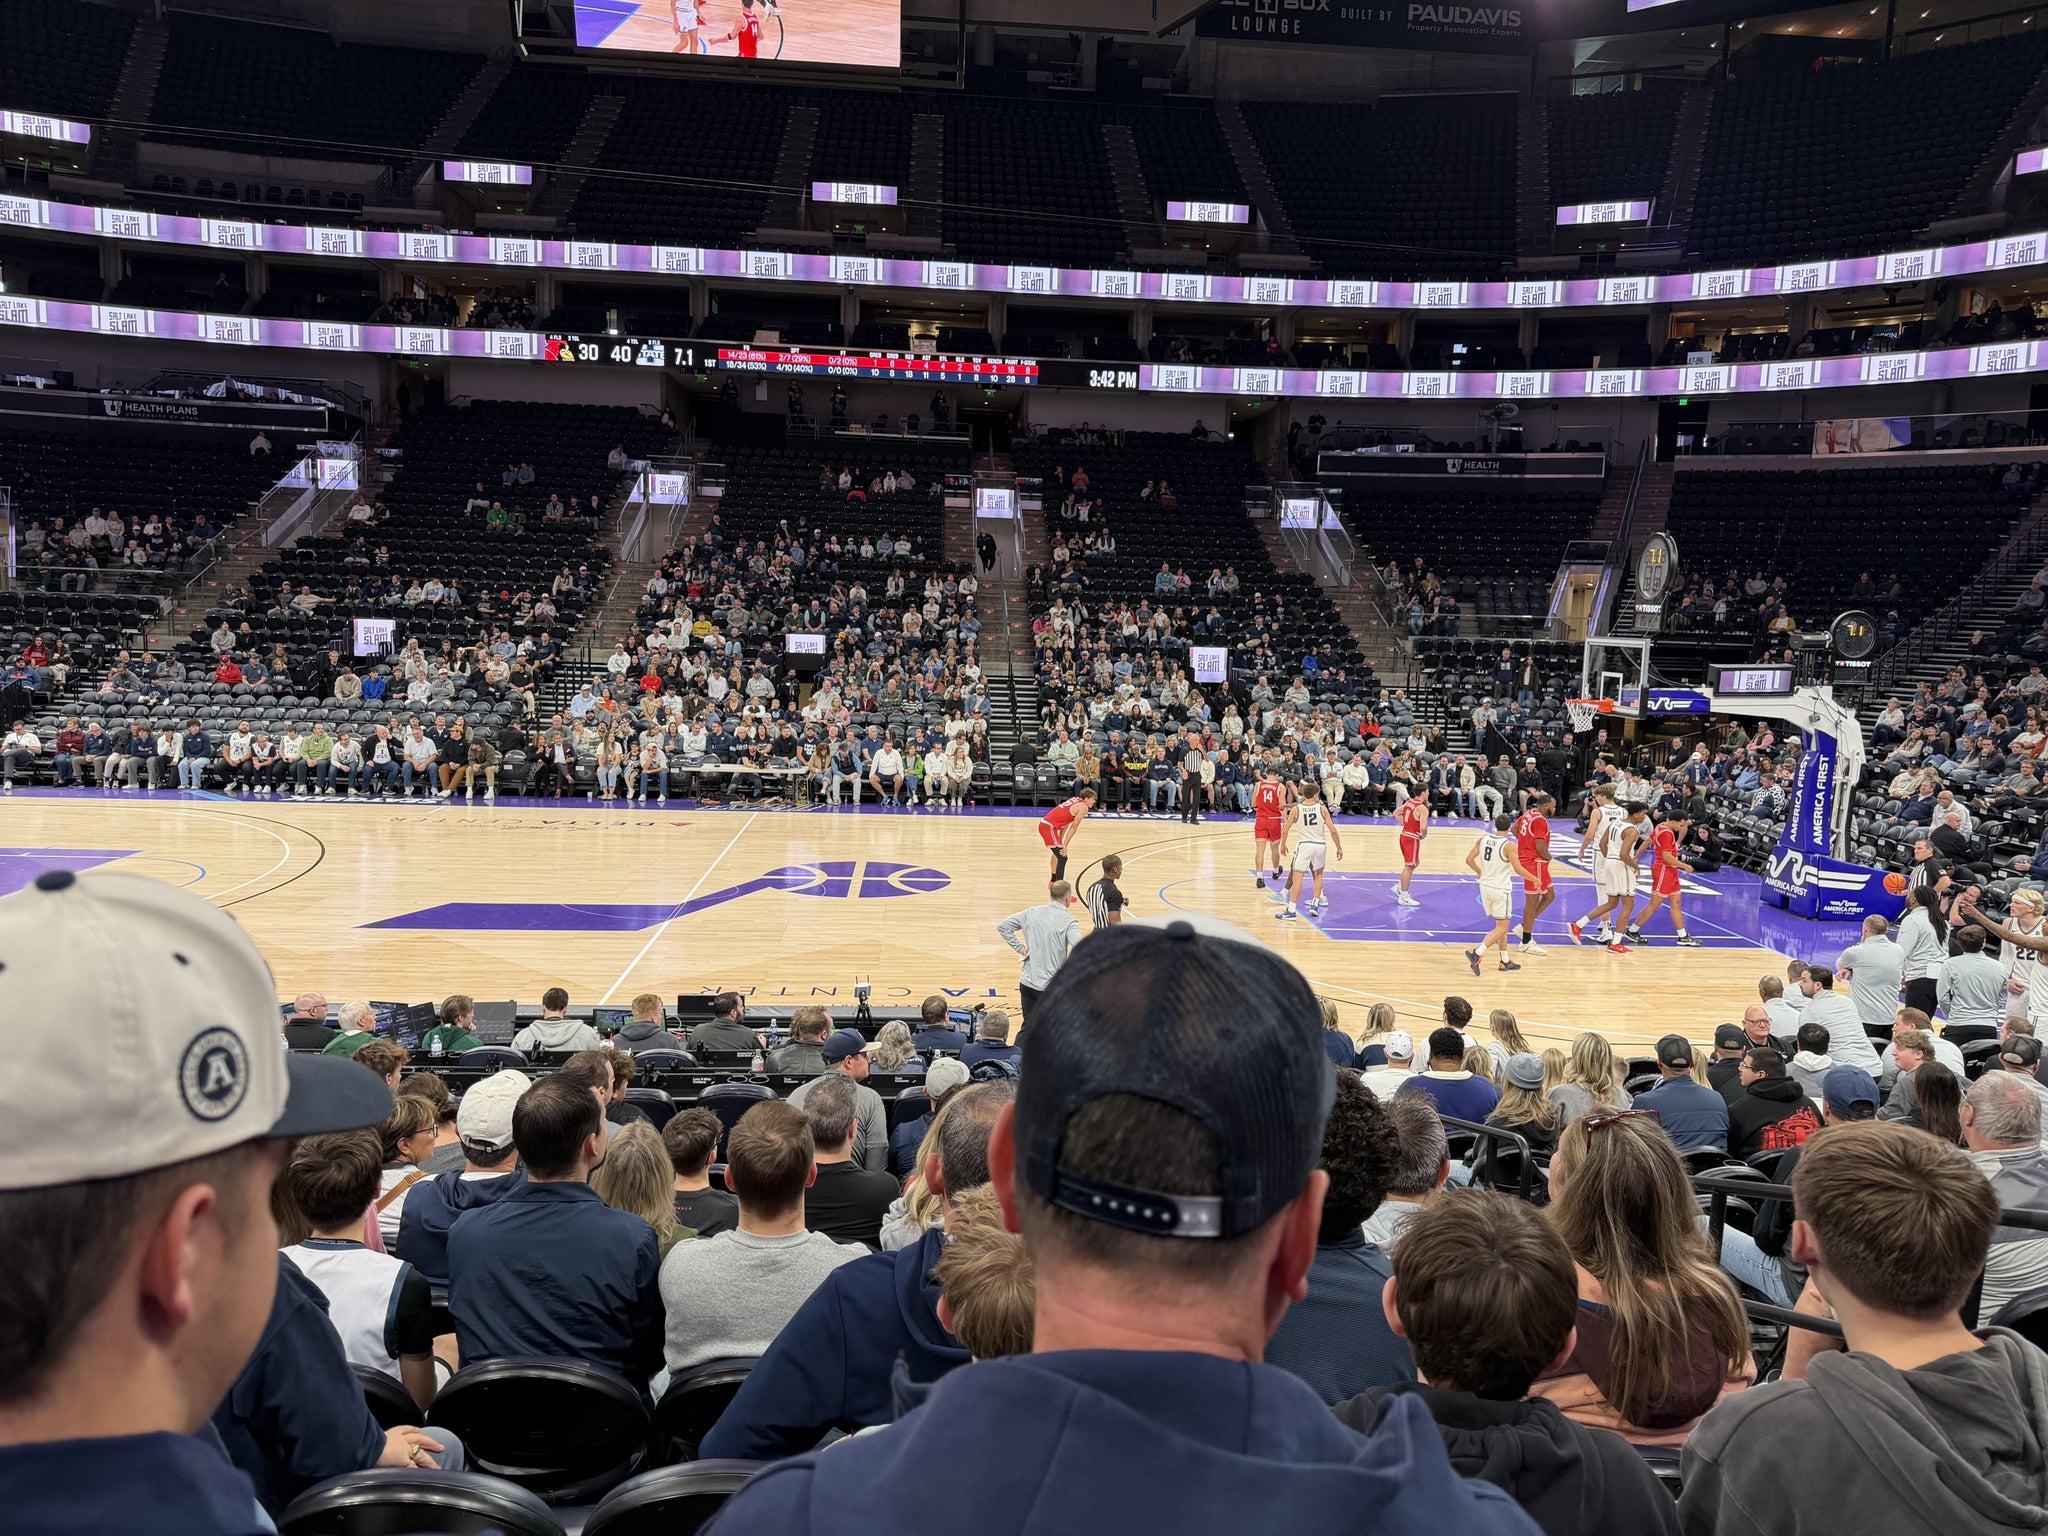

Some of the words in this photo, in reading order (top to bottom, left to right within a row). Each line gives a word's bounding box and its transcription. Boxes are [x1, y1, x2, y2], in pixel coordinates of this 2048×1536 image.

[1342, 8, 1372, 20] BUILT
[1380, 10, 1392, 22] BY
[1408, 4, 1521, 27] PAUDAVIS
[1232, 16, 1300, 34] LOUNGE
[1408, 23, 1441, 33] Property
[1444, 26, 1488, 34] Restoration
[1492, 28, 1520, 36] Experts
[22, 116, 35, 125] SALT
[23, 125, 51, 138] SLAM
[478, 172, 501, 183] SLAM
[1198, 211, 1220, 221] SLAM
[113, 223, 140, 236] SLAM
[2006, 243, 2019, 253] SALT
[2005, 248, 2036, 264] SLAM
[666, 259, 689, 271] SLAM
[1175, 287, 1197, 298] SLAM
[1709, 282, 1734, 295] SLAM
[110, 320, 137, 333] SLAM
[500, 344, 523, 356] SLAM
[579, 344, 598, 360] 30
[611, 346, 631, 362] 40
[674, 348, 692, 365] 7.1
[1988, 351, 2001, 360] SALT
[748, 362, 767, 370] (53%)
[794, 365, 813, 373] (40%)
[1988, 354, 2018, 371] SLAM
[1090, 370, 1114, 387] 3:42
[1118, 371, 1136, 388] PM
[1600, 381, 1625, 394] SLAM
[125, 403, 163, 413] HEALTH
[166, 405, 198, 415] PLANS
[1464, 461, 1499, 469] HEALTH
[987, 500, 1005, 509] SLAM
[364, 627, 374, 635] SALT
[364, 633, 387, 644] SLAM
[1198, 661, 1219, 672] SLAM
[1746, 680, 1766, 690] SLAM
[1818, 754, 1830, 790] FIRST
[1263, 790, 1272, 803] 14
[1790, 788, 1804, 842] AMERICA
[1798, 754, 1811, 787] FIRST
[1304, 813, 1317, 826] 12
[1813, 791, 1826, 846] AMERICA
[1611, 828, 1617, 842] 11
[1484, 847, 1492, 861] 8
[1765, 877, 1791, 892] AMERICA
[1790, 885, 1808, 897] FIRST
[2016, 946, 2035, 960] 22
[202, 1052, 235, 1094] A
